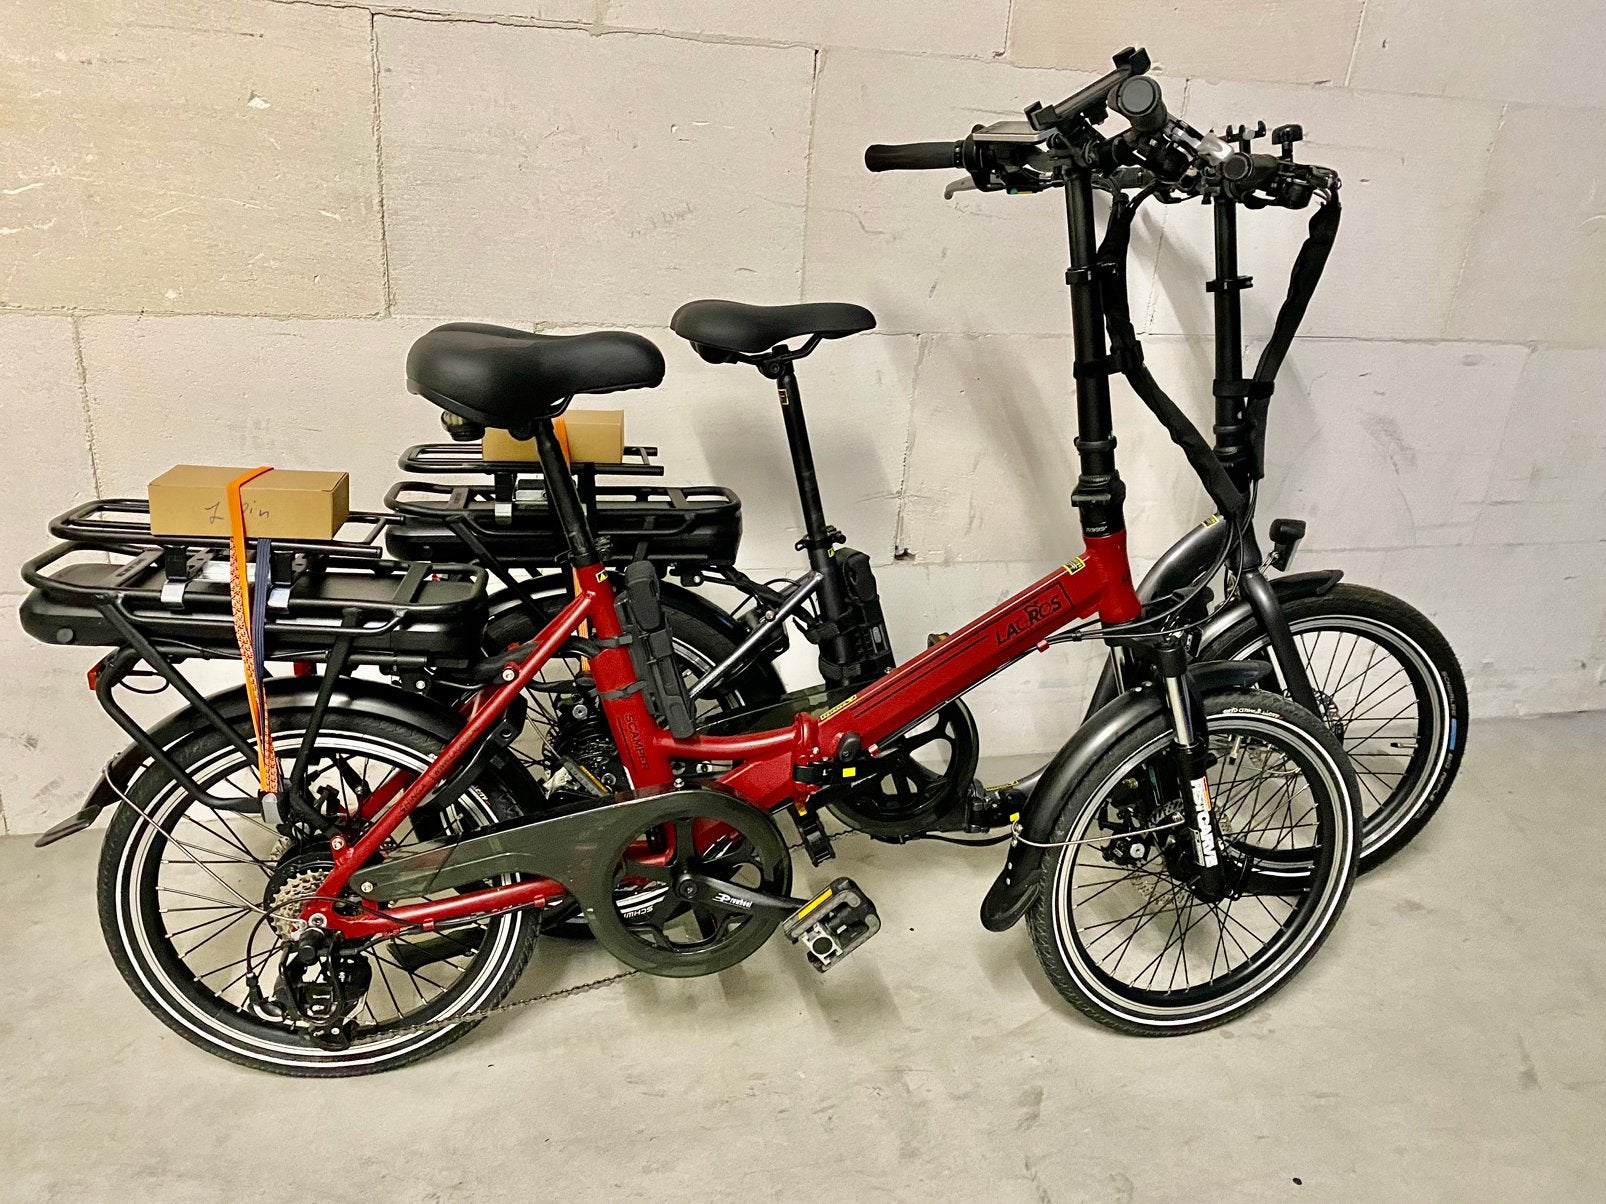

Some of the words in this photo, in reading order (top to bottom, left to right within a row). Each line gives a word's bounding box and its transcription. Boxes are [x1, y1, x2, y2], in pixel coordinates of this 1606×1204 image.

[995, 594, 1062, 646] LACROS
[624, 713, 650, 770] SCAMPER
[399, 783, 427, 815] SHINGA
